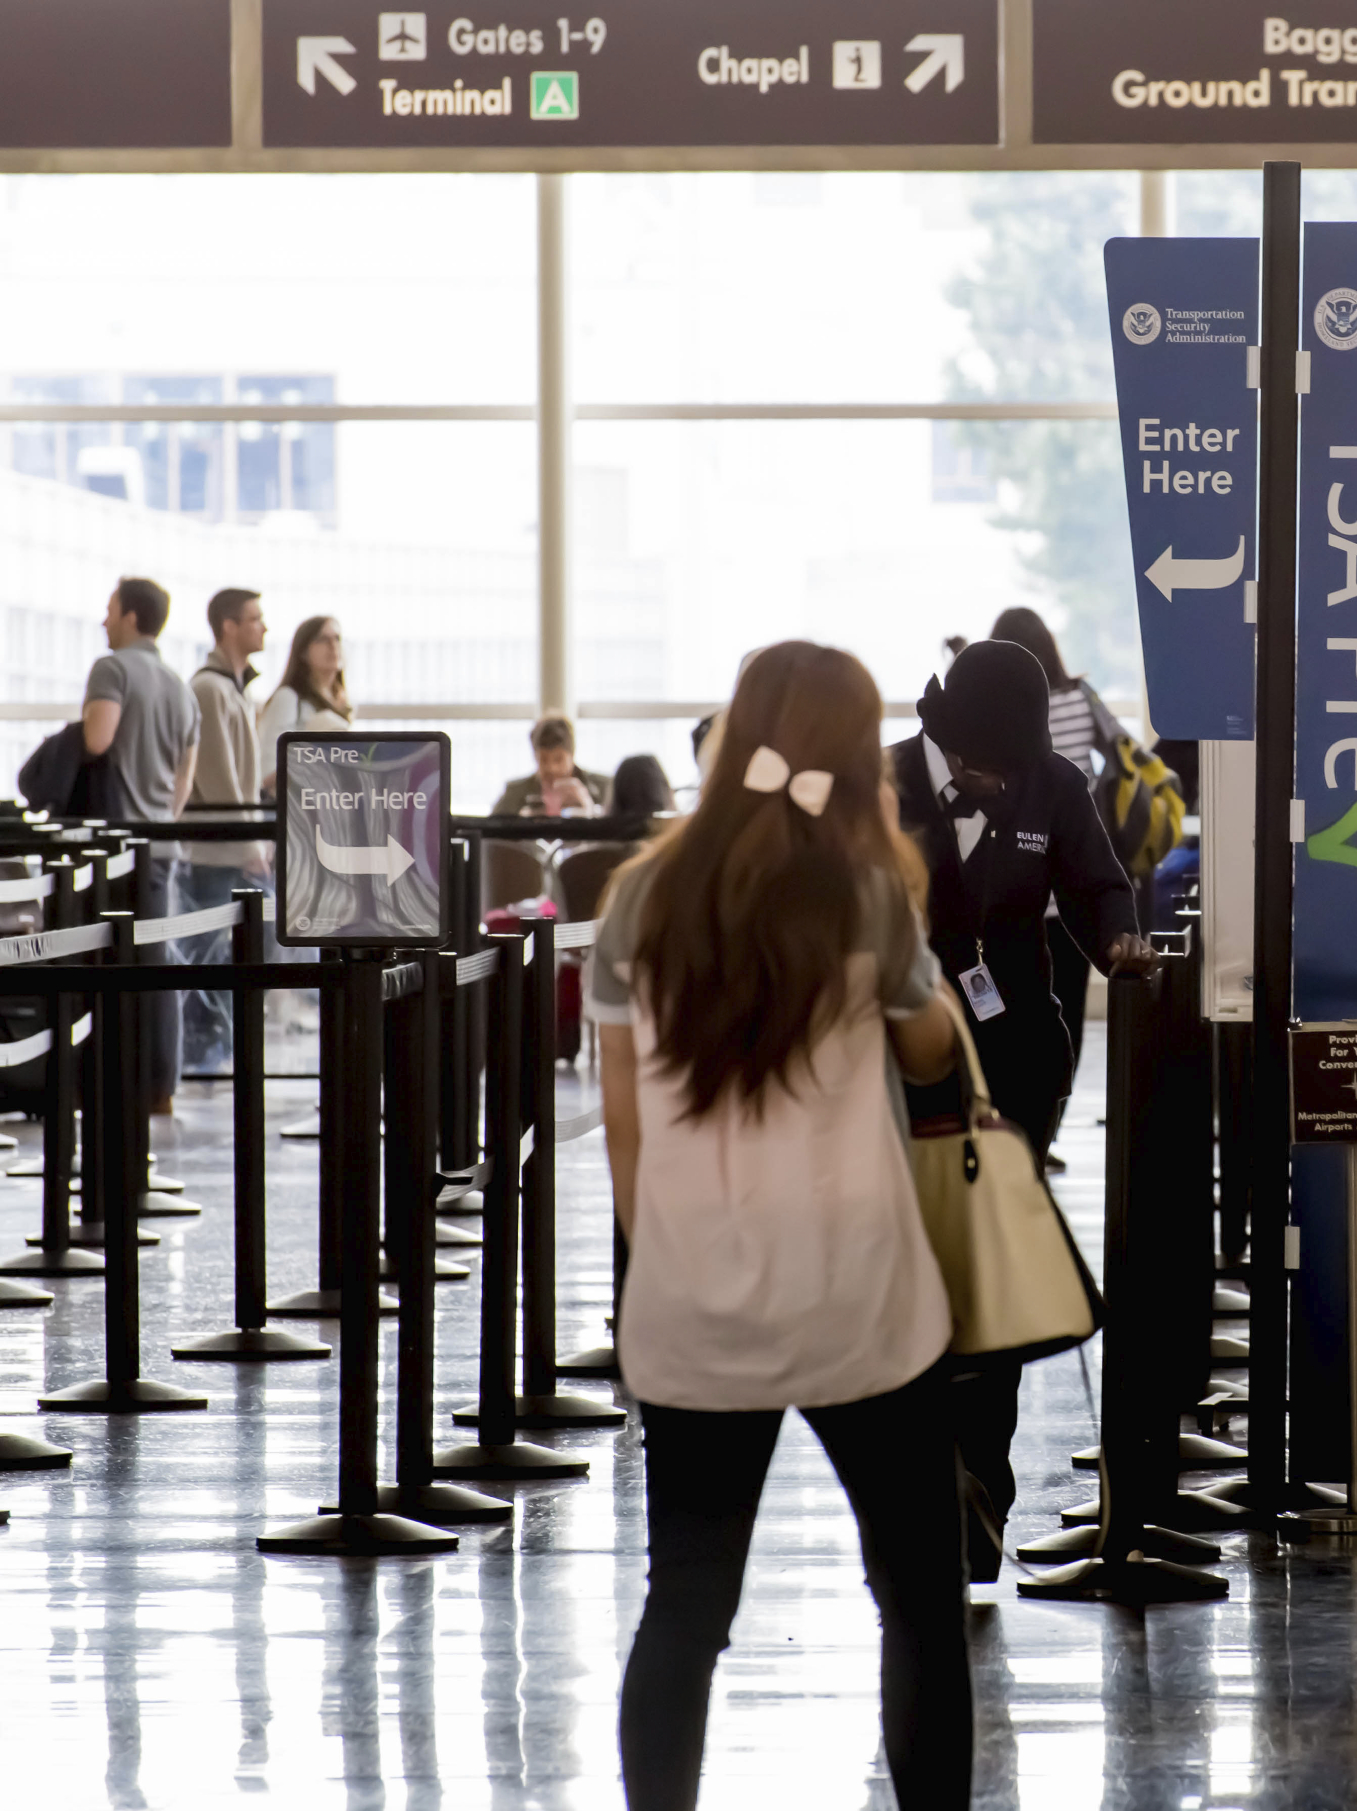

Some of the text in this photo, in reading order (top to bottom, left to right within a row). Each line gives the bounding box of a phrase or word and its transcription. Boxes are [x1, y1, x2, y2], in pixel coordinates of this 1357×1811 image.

[448, 17, 607, 55] Gates 1-9
[698, 45, 809, 93] Chapel
[1111, 67, 1271, 109] Ground
[380, 77, 573, 117] Terminal A
[1165, 308, 1245, 321] Transportation
[1165, 321, 1211, 333] Security
[1165, 332, 1246, 343] Administration
[1138, 418, 1240, 452] Enter
[1142, 460, 1233, 494] Here
[293, 747, 359, 763] TSA Pre
[301, 788, 427, 810] Enter Here
[1016, 831, 1044, 842] EULEN
[1330, 1047, 1349, 1057] For
[1298, 1111, 1357, 1121] Metropolitan
[1314, 1122, 1353, 1132] Airports
